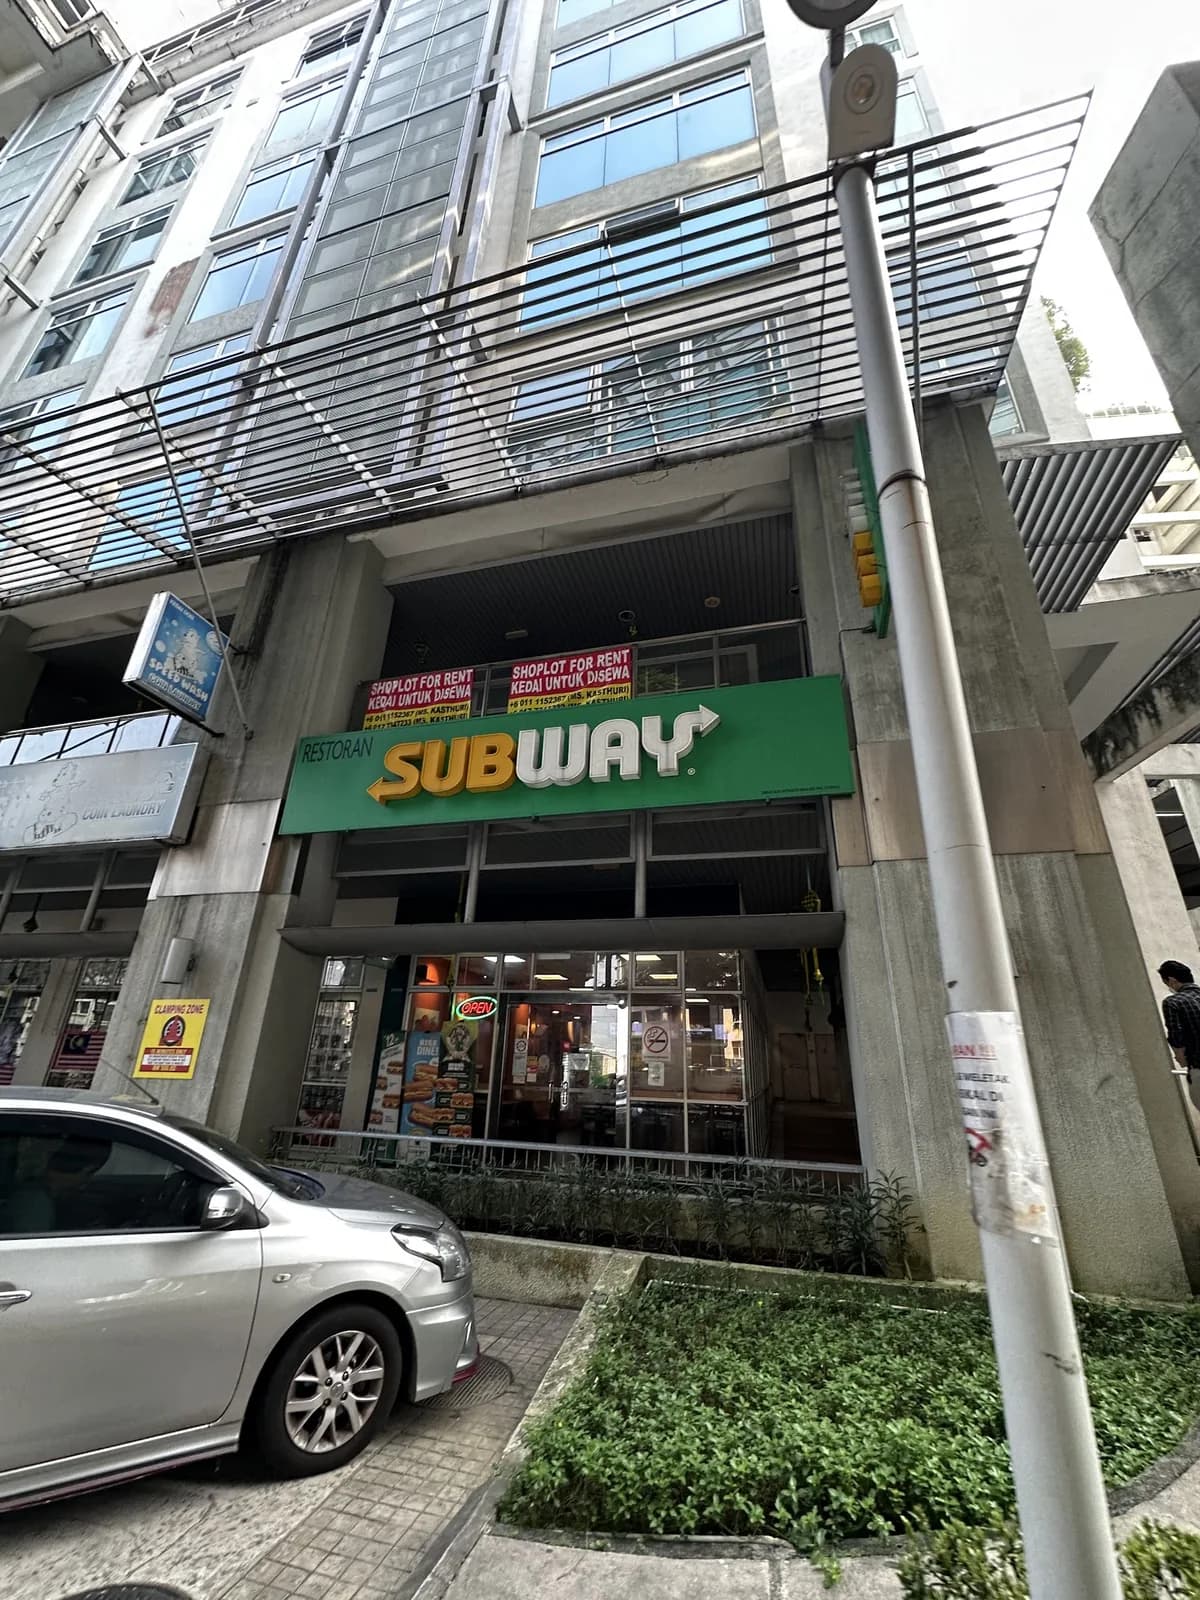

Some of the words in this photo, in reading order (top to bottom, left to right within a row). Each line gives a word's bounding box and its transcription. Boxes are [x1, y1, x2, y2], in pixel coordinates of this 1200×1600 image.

[512, 660, 567, 679] SHOPLOT
[569, 656, 593, 673] FOR
[596, 649, 630, 668] RENT
[149, 658, 181, 684] SPEED
[181, 678, 209, 703] WASH
[370, 677, 418, 696] SHOPLOT
[419, 674, 440, 690] FOR
[443, 668, 474, 686] RENT
[510, 680, 543, 695] KEDAI
[545, 672, 584, 691] UNTUK
[587, 665, 630, 684] DISEWA
[368, 695, 397, 710] KEDAI
[398, 690, 432, 706] UNTUK
[433, 684, 471, 702] DISEWA
[302, 736, 374, 763] RESTORAN
[366, 704, 720, 806] SUBWAY
[110, 799, 167, 819] LAUNDRY
[154, 1004, 186, 1015] CLAMPING
[186, 1003, 205, 1014] ZONE
[461, 1001, 493, 1014] OPEN
